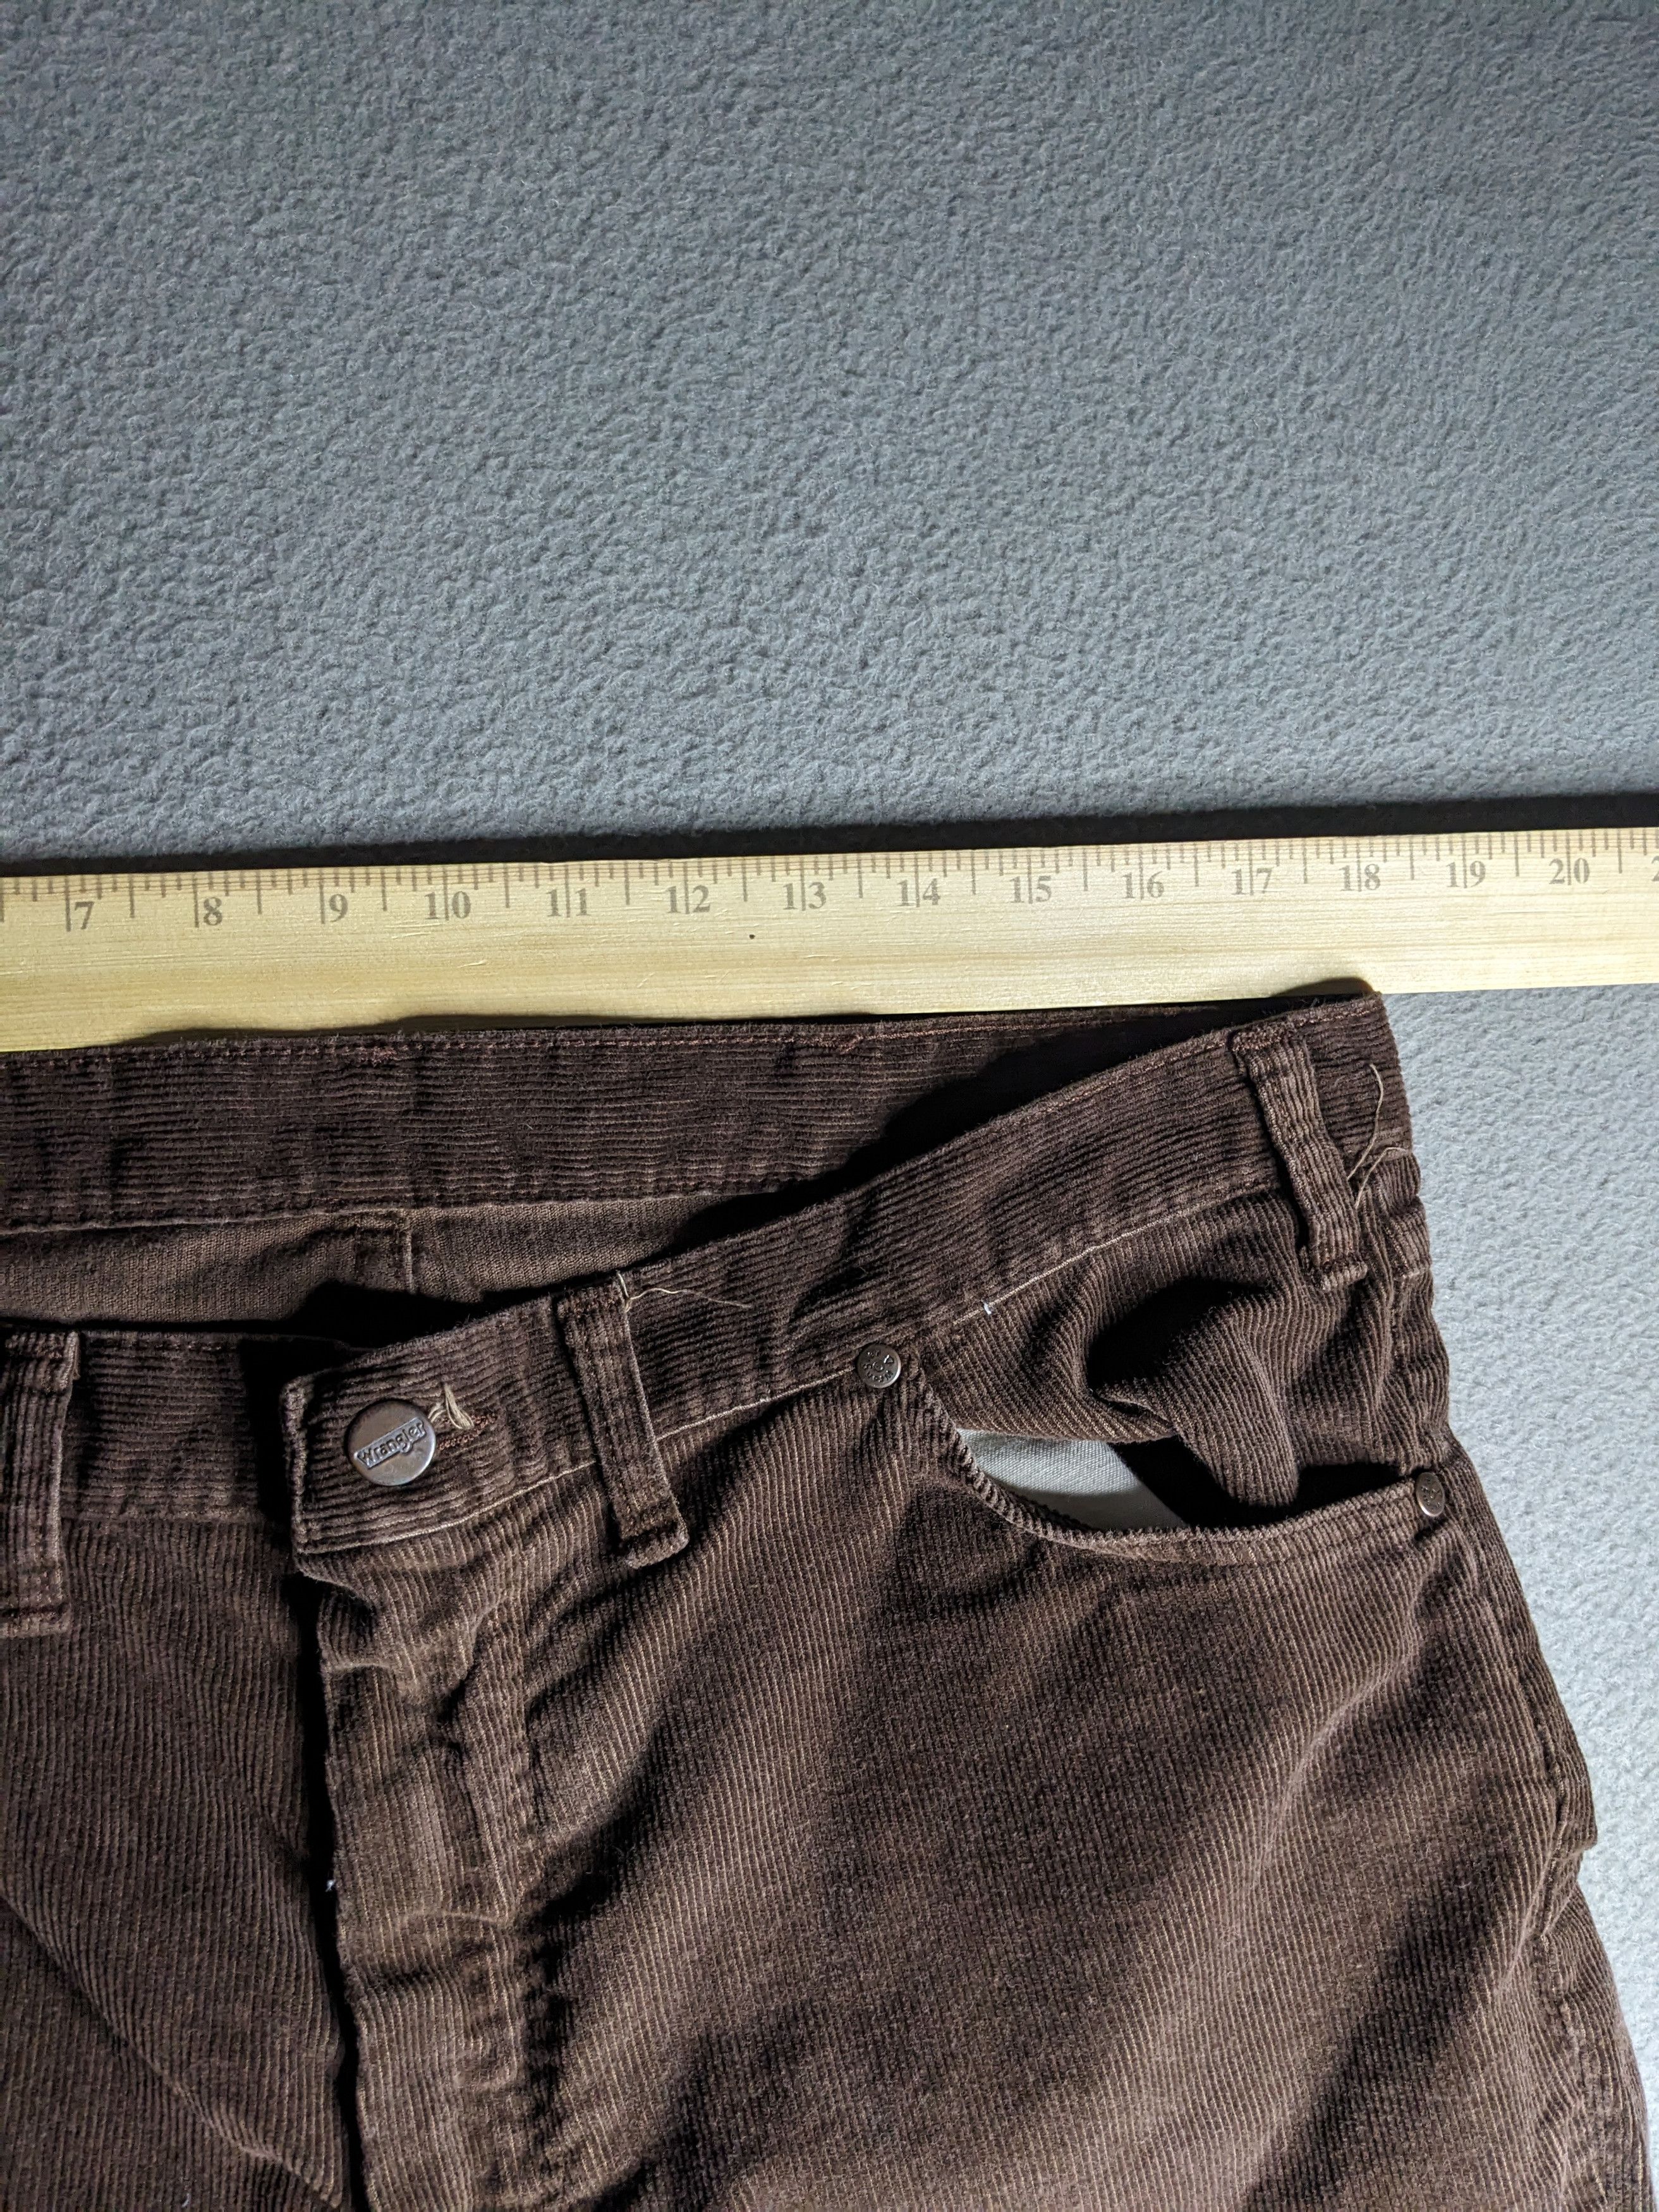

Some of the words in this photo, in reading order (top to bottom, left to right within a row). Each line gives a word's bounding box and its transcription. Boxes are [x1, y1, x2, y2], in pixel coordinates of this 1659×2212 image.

[74, 901, 94, 930] 7
[203, 897, 223, 925] 8
[329, 894, 348, 922] 9
[424, 891, 471, 920] 10
[546, 888, 592, 917] 11
[667, 885, 711, 913] 12
[783, 882, 827, 909] 13
[896, 877, 940, 907] 14
[1010, 875, 1052, 904] 15
[1122, 872, 1164, 899] 16
[1232, 867, 1273, 895] 17
[1339, 863, 1381, 891] 18
[1446, 860, 1486, 888] 19
[1548, 857, 1590, 884] 20
[357, 1421, 427, 1466] Wrangler
